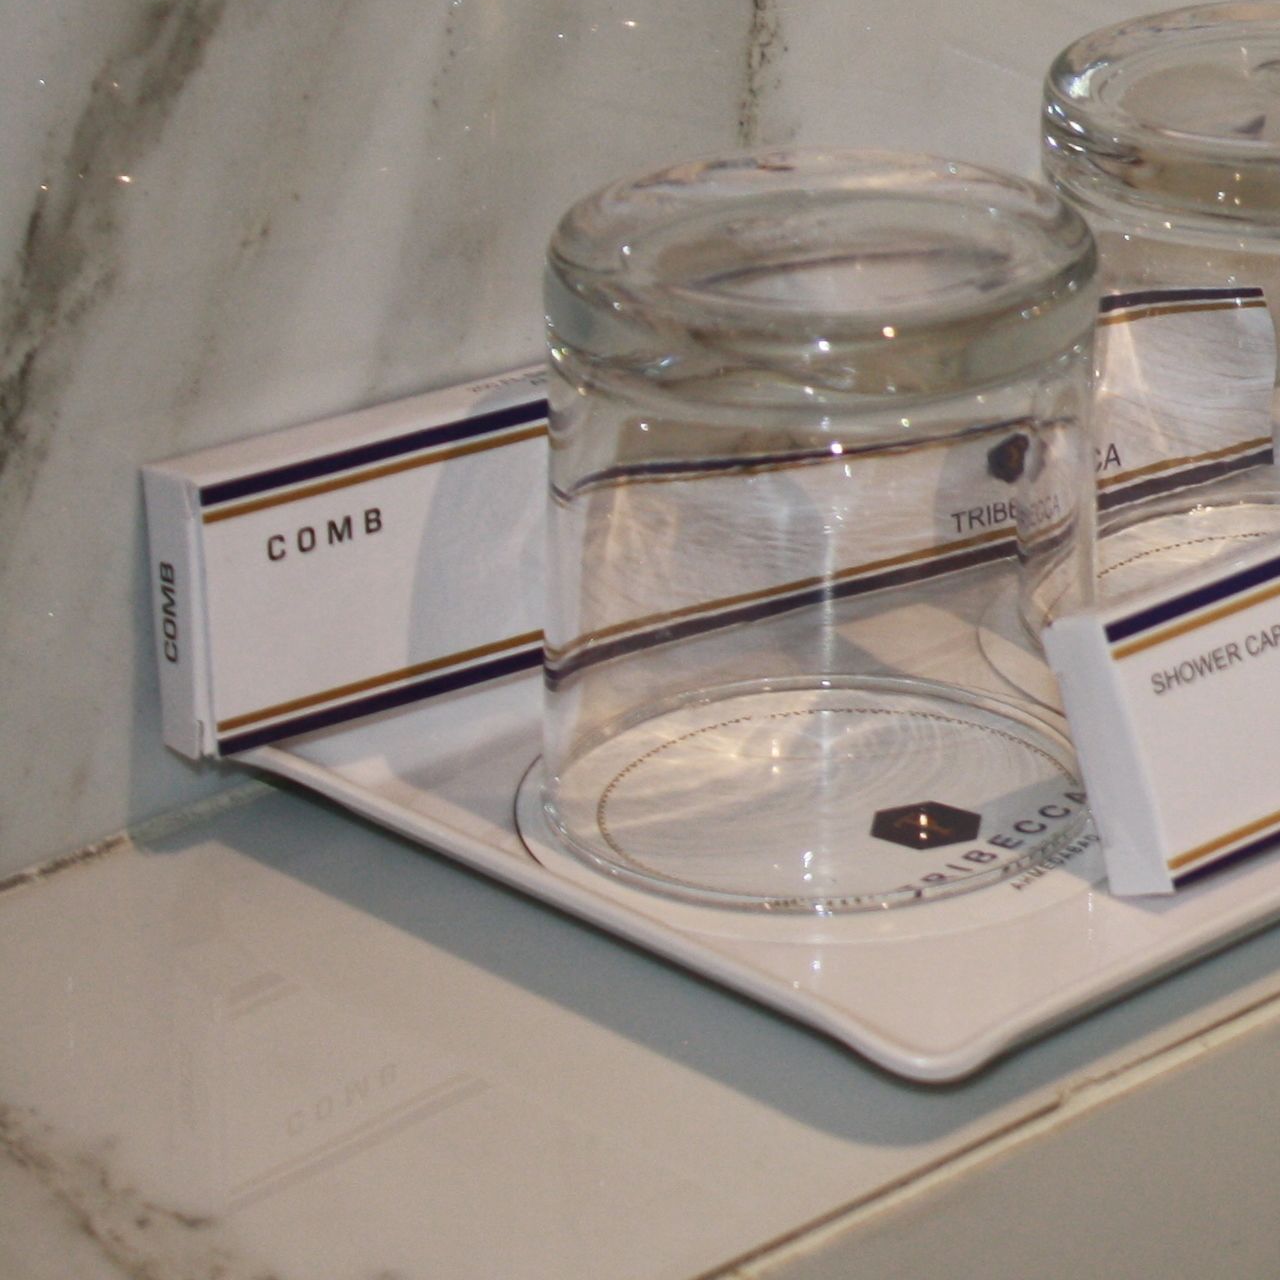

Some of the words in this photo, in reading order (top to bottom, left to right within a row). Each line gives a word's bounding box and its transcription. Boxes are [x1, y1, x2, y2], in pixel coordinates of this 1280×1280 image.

[267, 507, 383, 561] COMB
[159, 561, 179, 663] COMB
[1150, 641, 1244, 697] SHOWER
